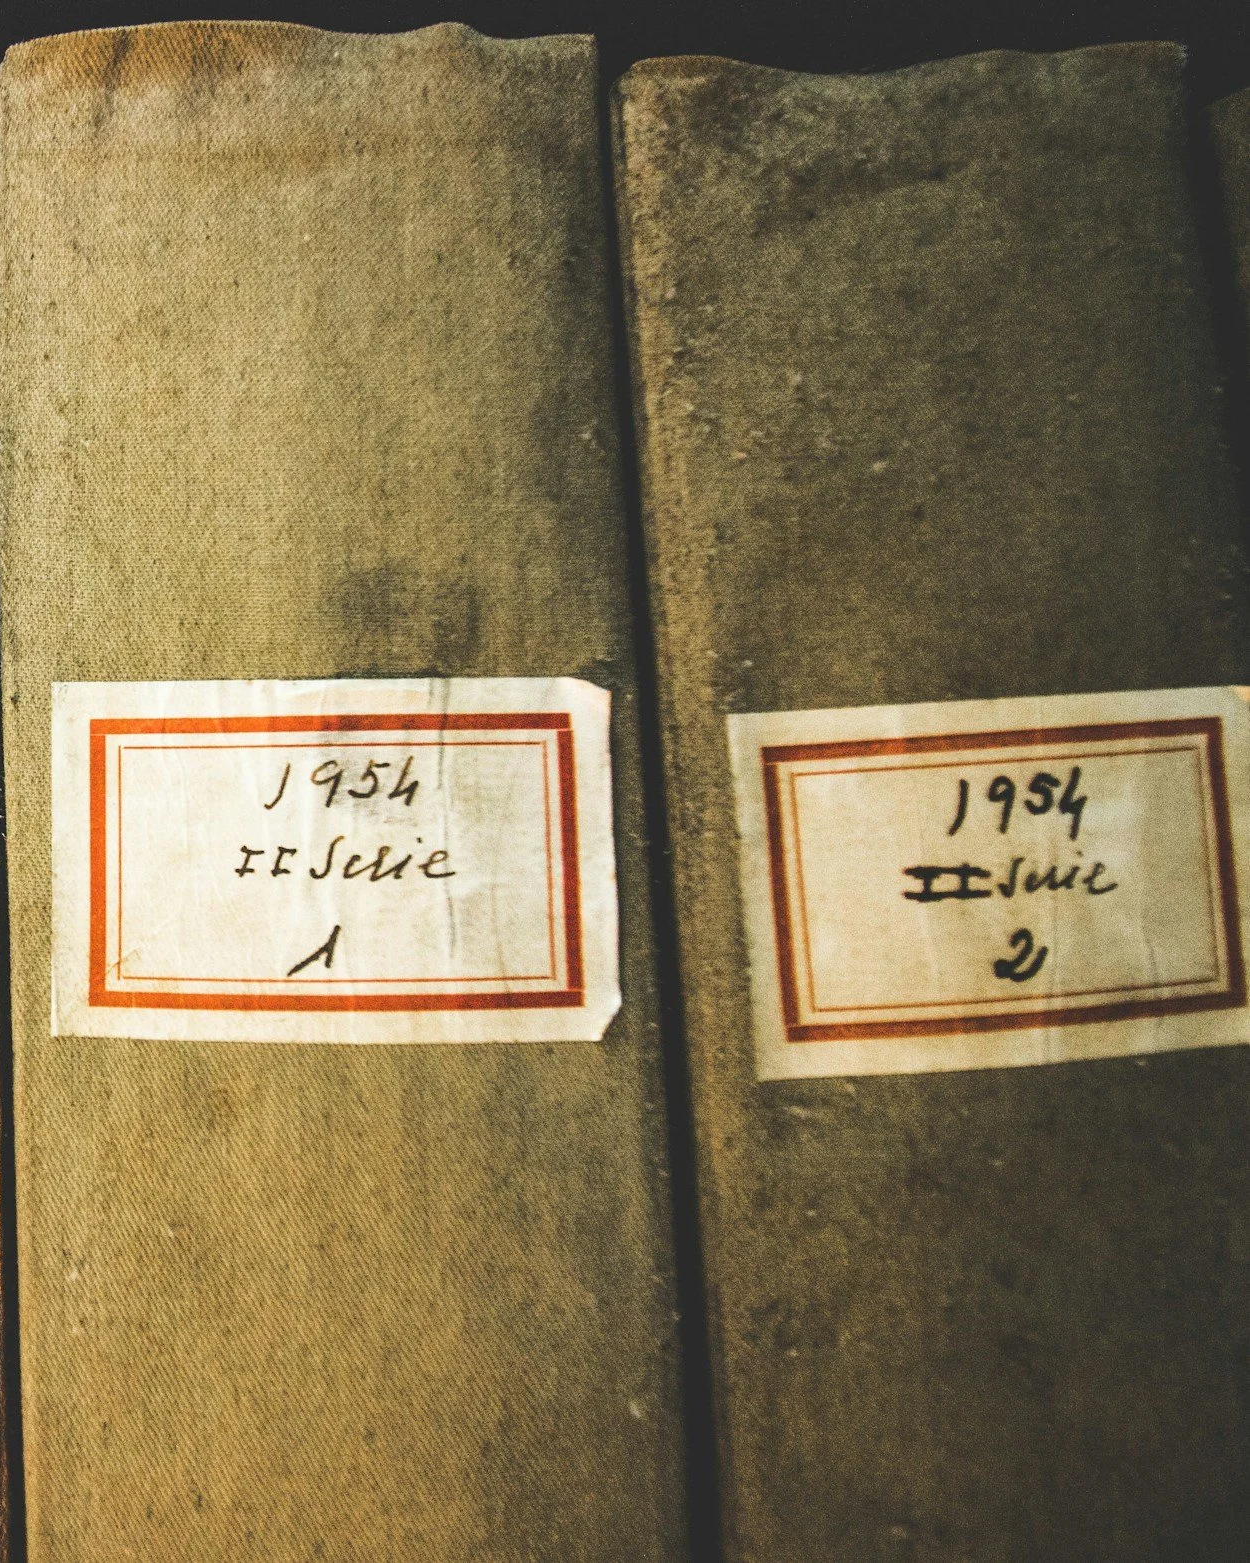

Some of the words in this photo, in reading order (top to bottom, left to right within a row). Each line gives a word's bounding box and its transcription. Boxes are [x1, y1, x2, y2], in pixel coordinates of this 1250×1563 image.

[264, 756, 419, 810] 1954
[948, 765, 1088, 841] 1954
[902, 862, 992, 903] II
[287, 924, 342, 977] 1
[992, 928, 1049, 983] 2
